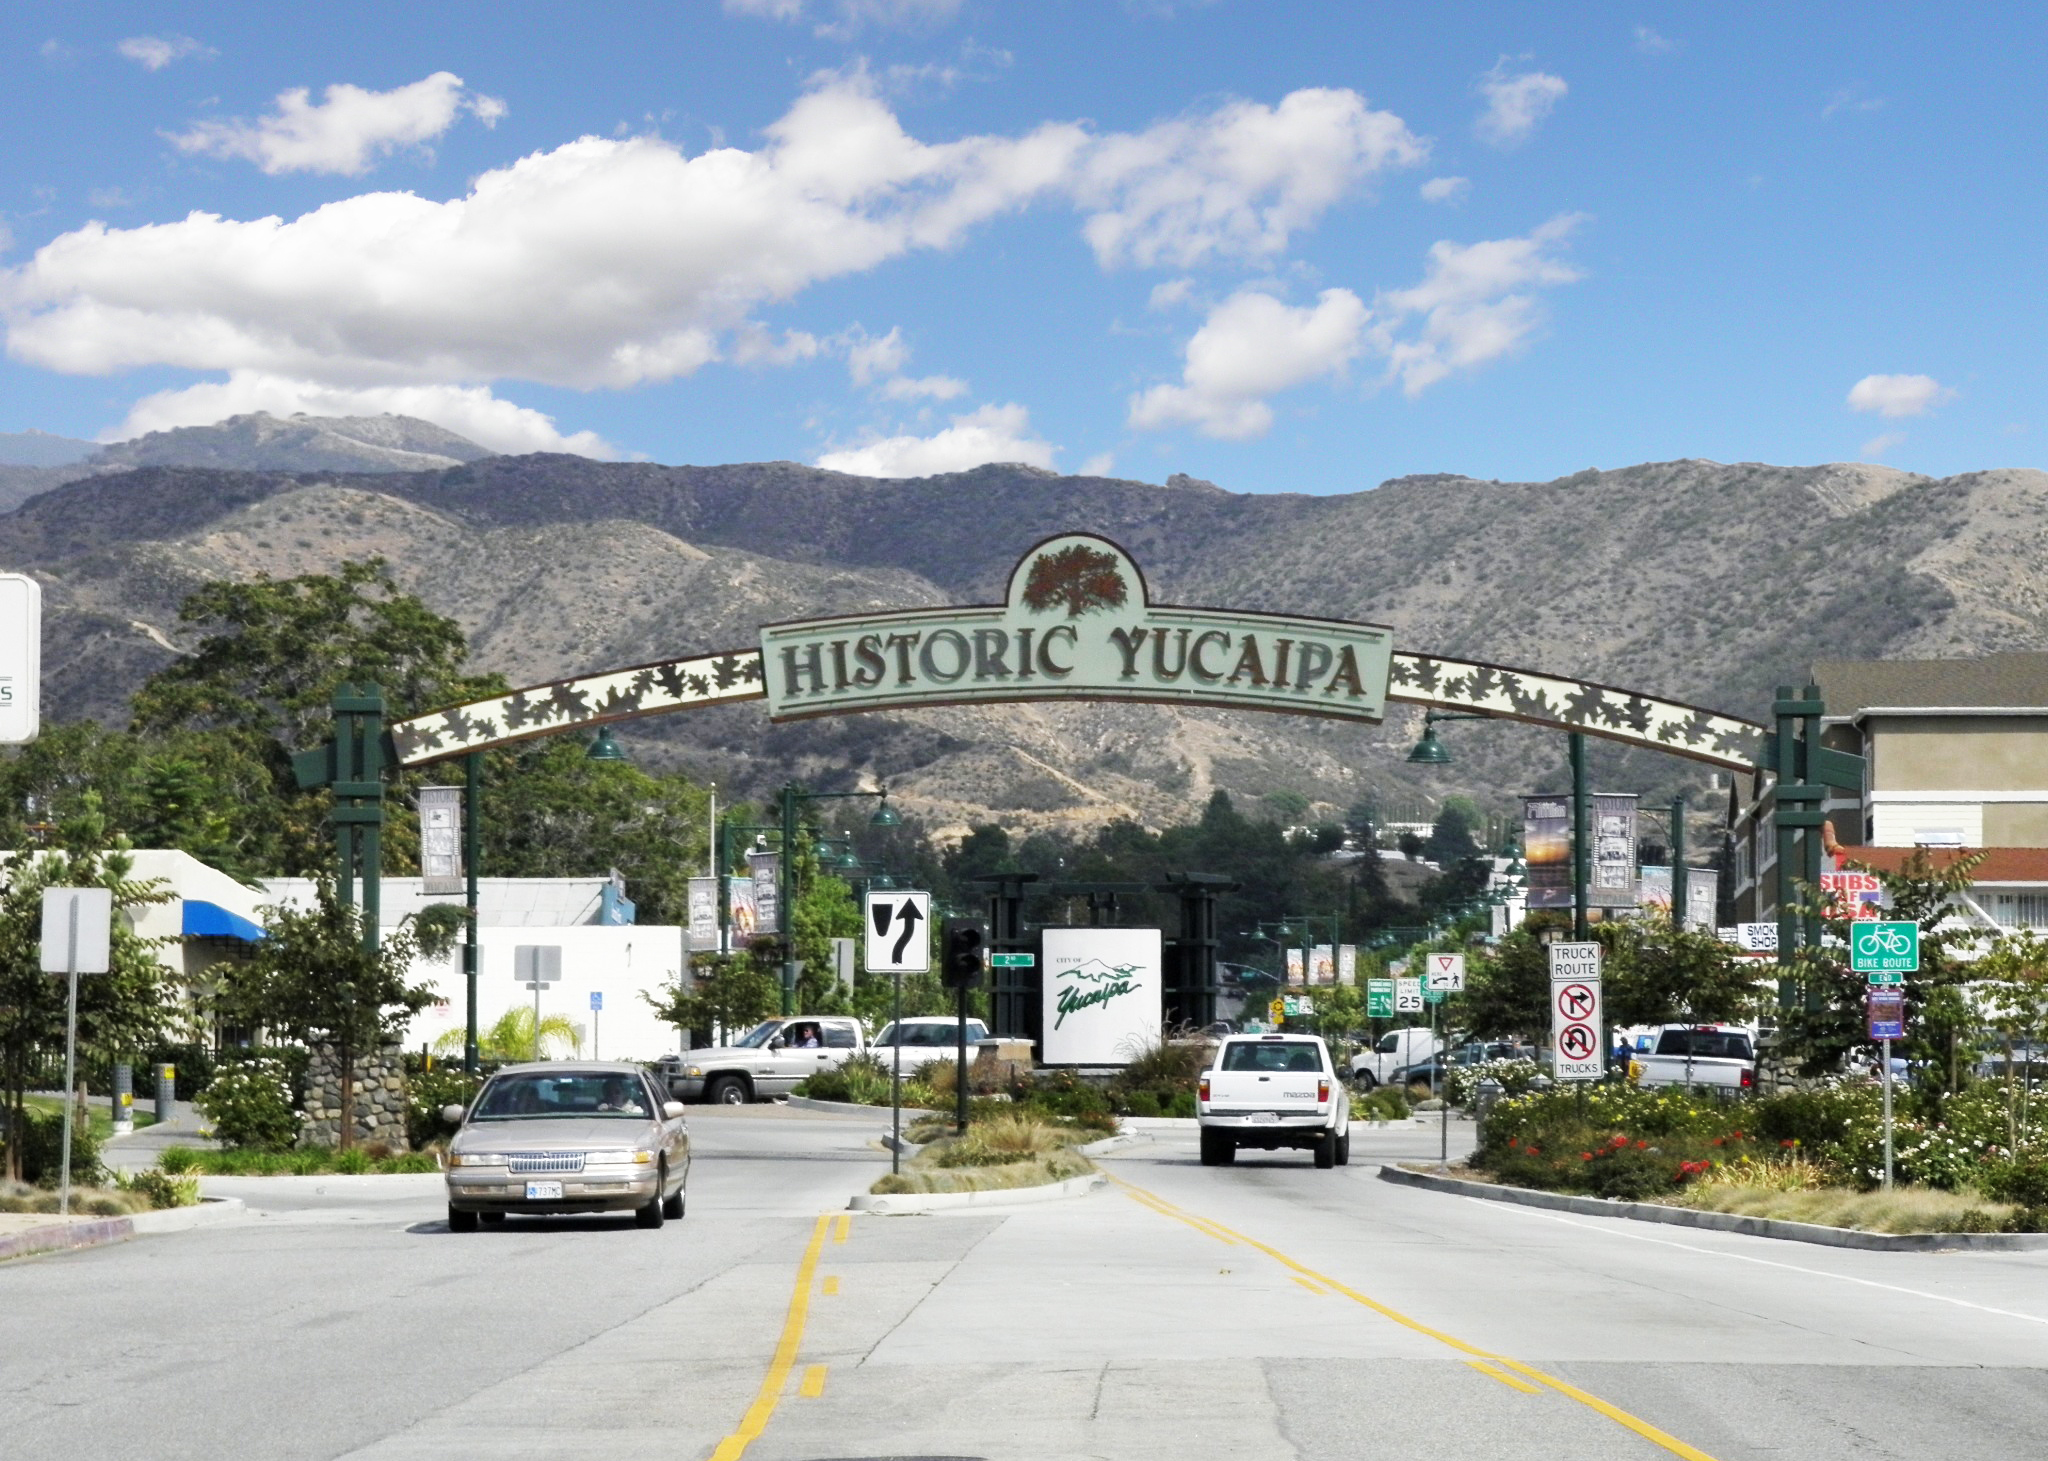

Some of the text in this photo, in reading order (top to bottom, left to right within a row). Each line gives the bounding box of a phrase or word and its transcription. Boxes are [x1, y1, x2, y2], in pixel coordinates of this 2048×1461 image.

[781, 625, 1369, 697] HISTORIC YUCAIPA
[1820, 874, 1878, 891] SUBS
[1747, 925, 1778, 937] SMOK
[1751, 937, 1777, 948] SHOP
[1555, 947, 1596, 960] TRUCK
[1857, 957, 1912, 968] BIKE ROUTE
[1555, 963, 1596, 975] ROUTE
[1053, 980, 1143, 1031] Yucaipa
[1399, 996, 1421, 1009] 25
[1560, 1063, 1598, 1074] TRUCKS
